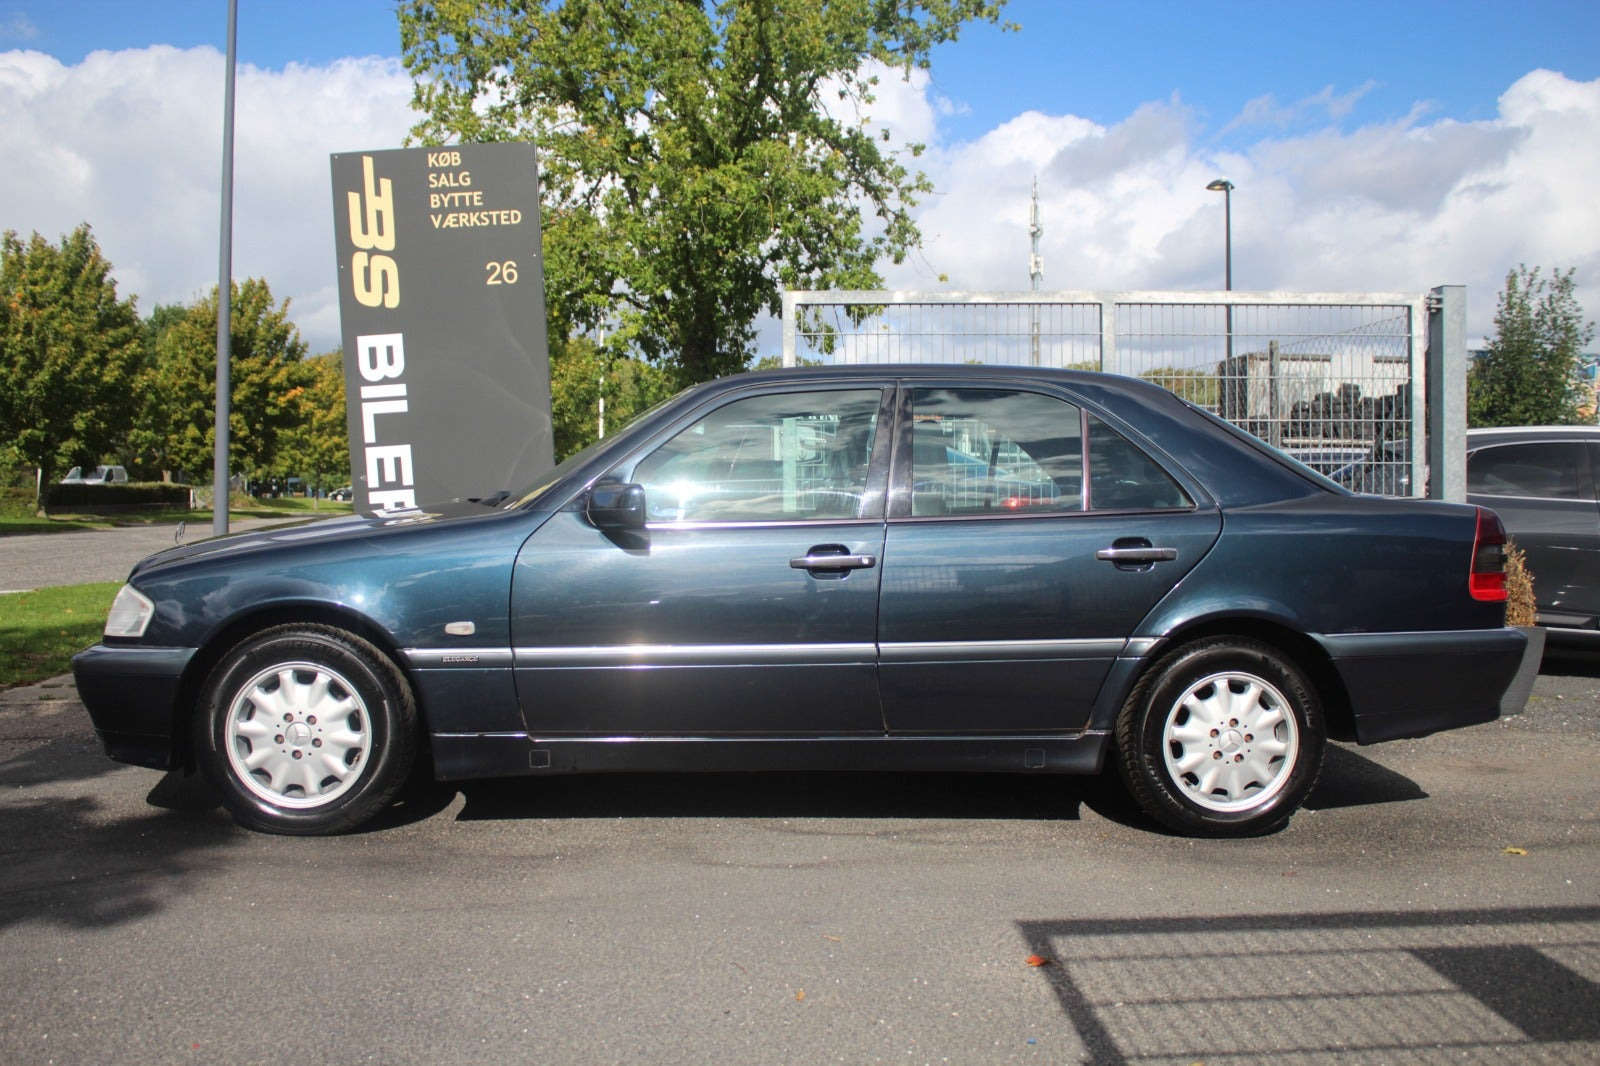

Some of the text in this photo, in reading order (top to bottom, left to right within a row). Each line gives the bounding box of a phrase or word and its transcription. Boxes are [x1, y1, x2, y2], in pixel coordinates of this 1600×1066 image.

[427, 151, 462, 168] KØB
[428, 171, 472, 189] SALG
[430, 191, 484, 209] BYTTE
[430, 209, 522, 229] VÆRKSTED
[485, 260, 519, 286] 26
